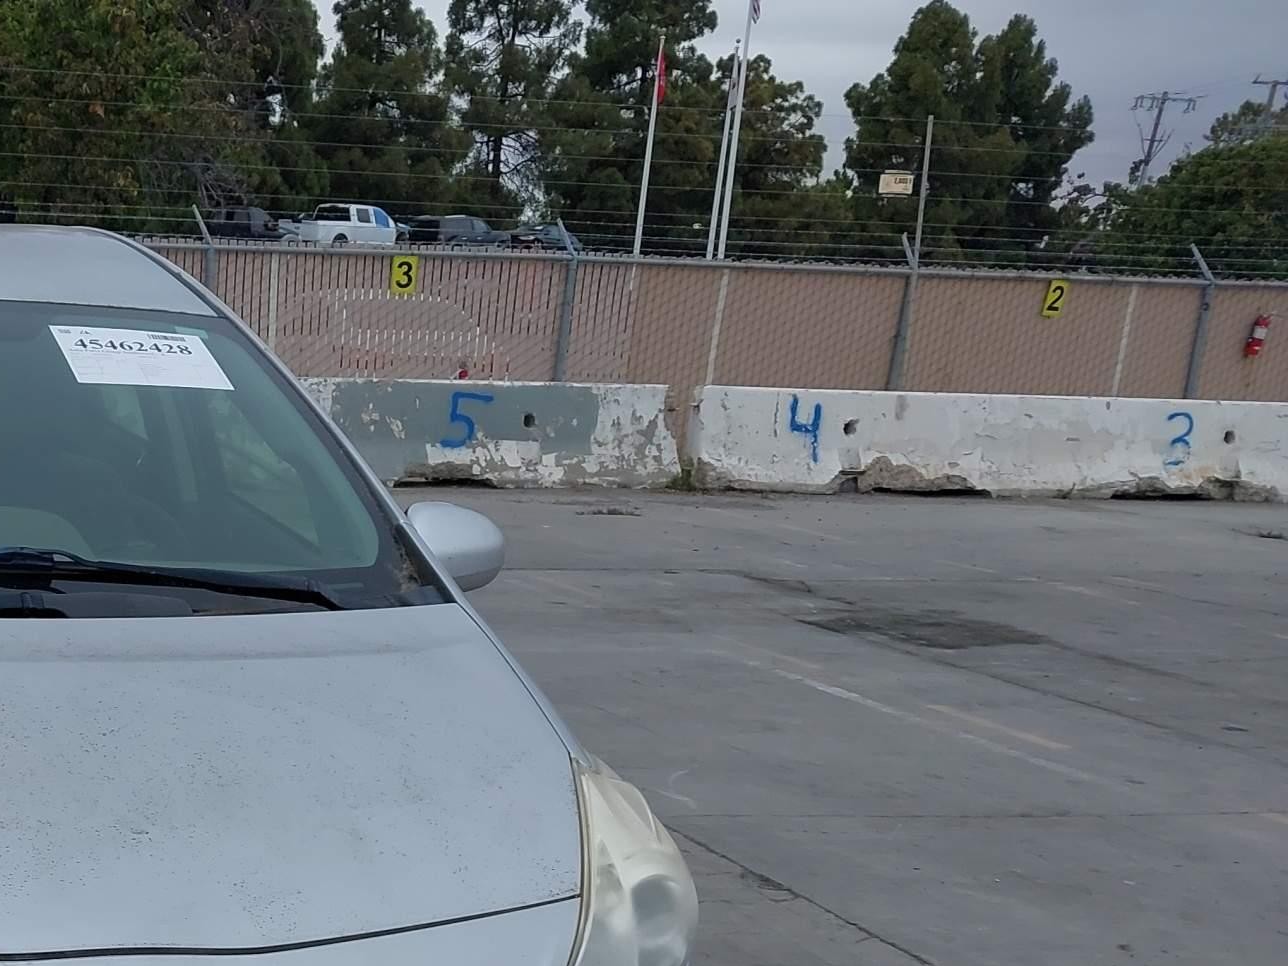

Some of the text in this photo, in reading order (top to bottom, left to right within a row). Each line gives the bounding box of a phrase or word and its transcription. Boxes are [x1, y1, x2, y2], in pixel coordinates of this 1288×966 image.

[395, 261, 413, 288] 3
[1046, 285, 1065, 311] 2
[74, 338, 193, 355] 45462428
[440, 390, 494, 448] 5
[789, 393, 822, 463] 4
